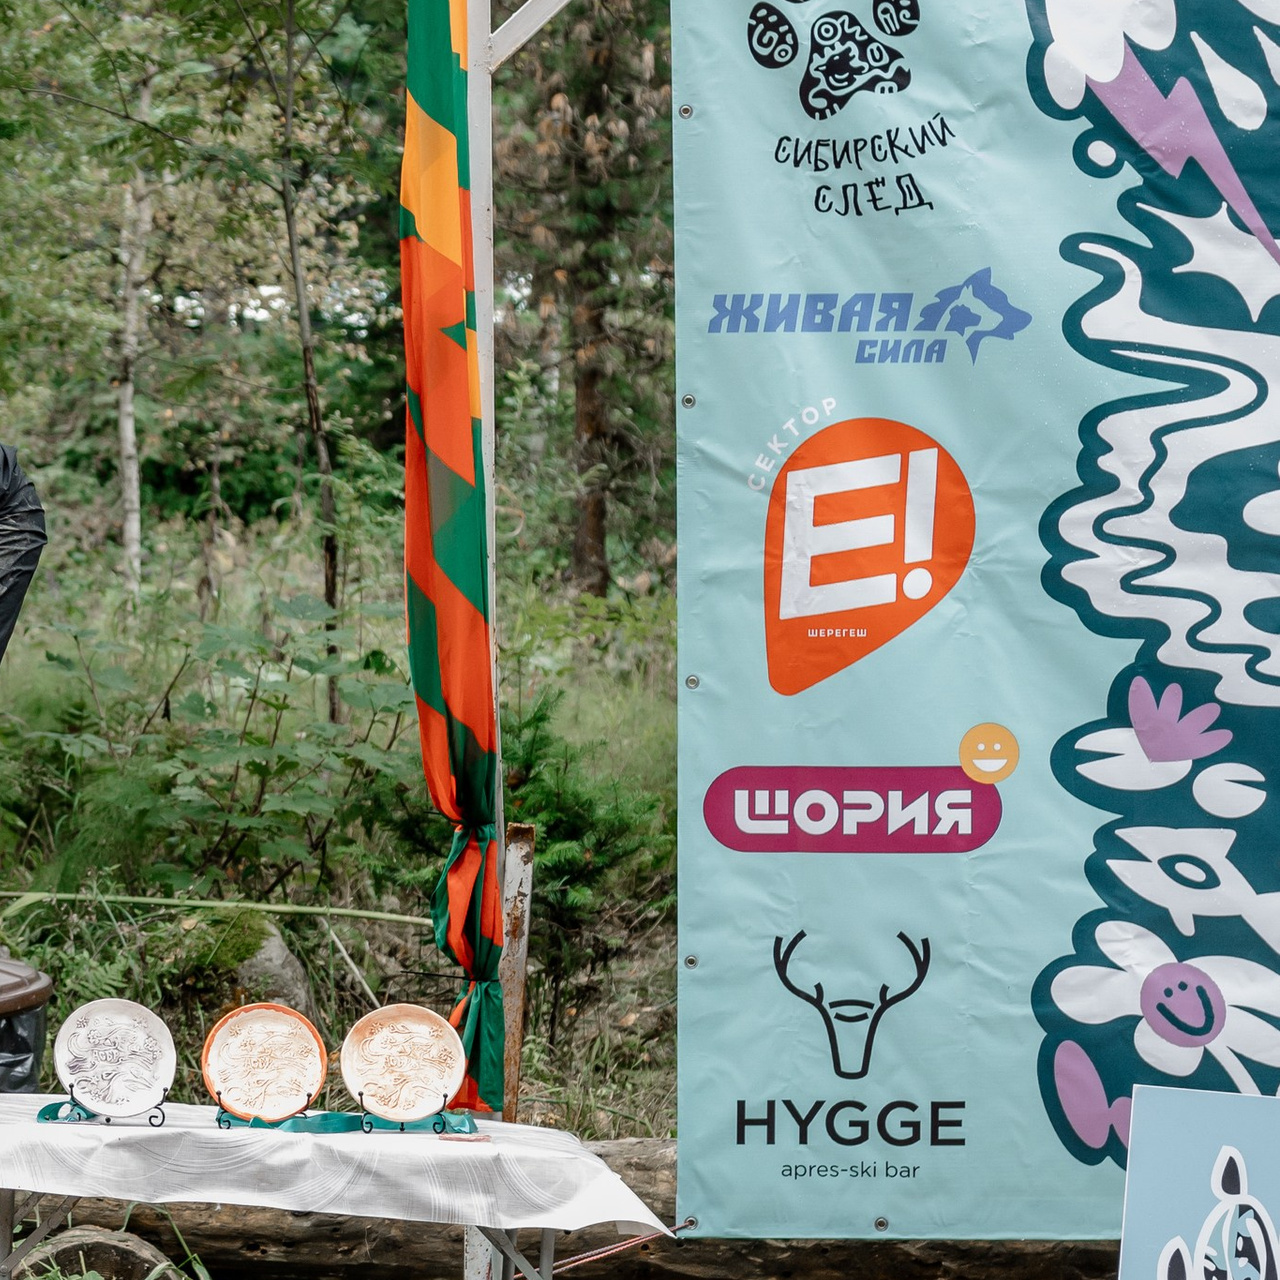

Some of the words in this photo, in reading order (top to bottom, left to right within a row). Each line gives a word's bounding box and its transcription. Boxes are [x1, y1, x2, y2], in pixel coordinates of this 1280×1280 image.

[774, 112, 956, 172] СИБИРСКИЙ
[707, 293, 914, 333] ЖИВАЯ
[855, 339, 948, 364] СИЛА
[747, 397, 837, 491] СЕКТОР
[808, 628, 867, 638] ШЕРЕГЕШ
[734, 789, 972, 836] ШОРИЯ
[736, 1100, 966, 1147] HYGGE
[781, 1161, 877, 1180] apres-ski
[885, 1161, 921, 1178] bar
